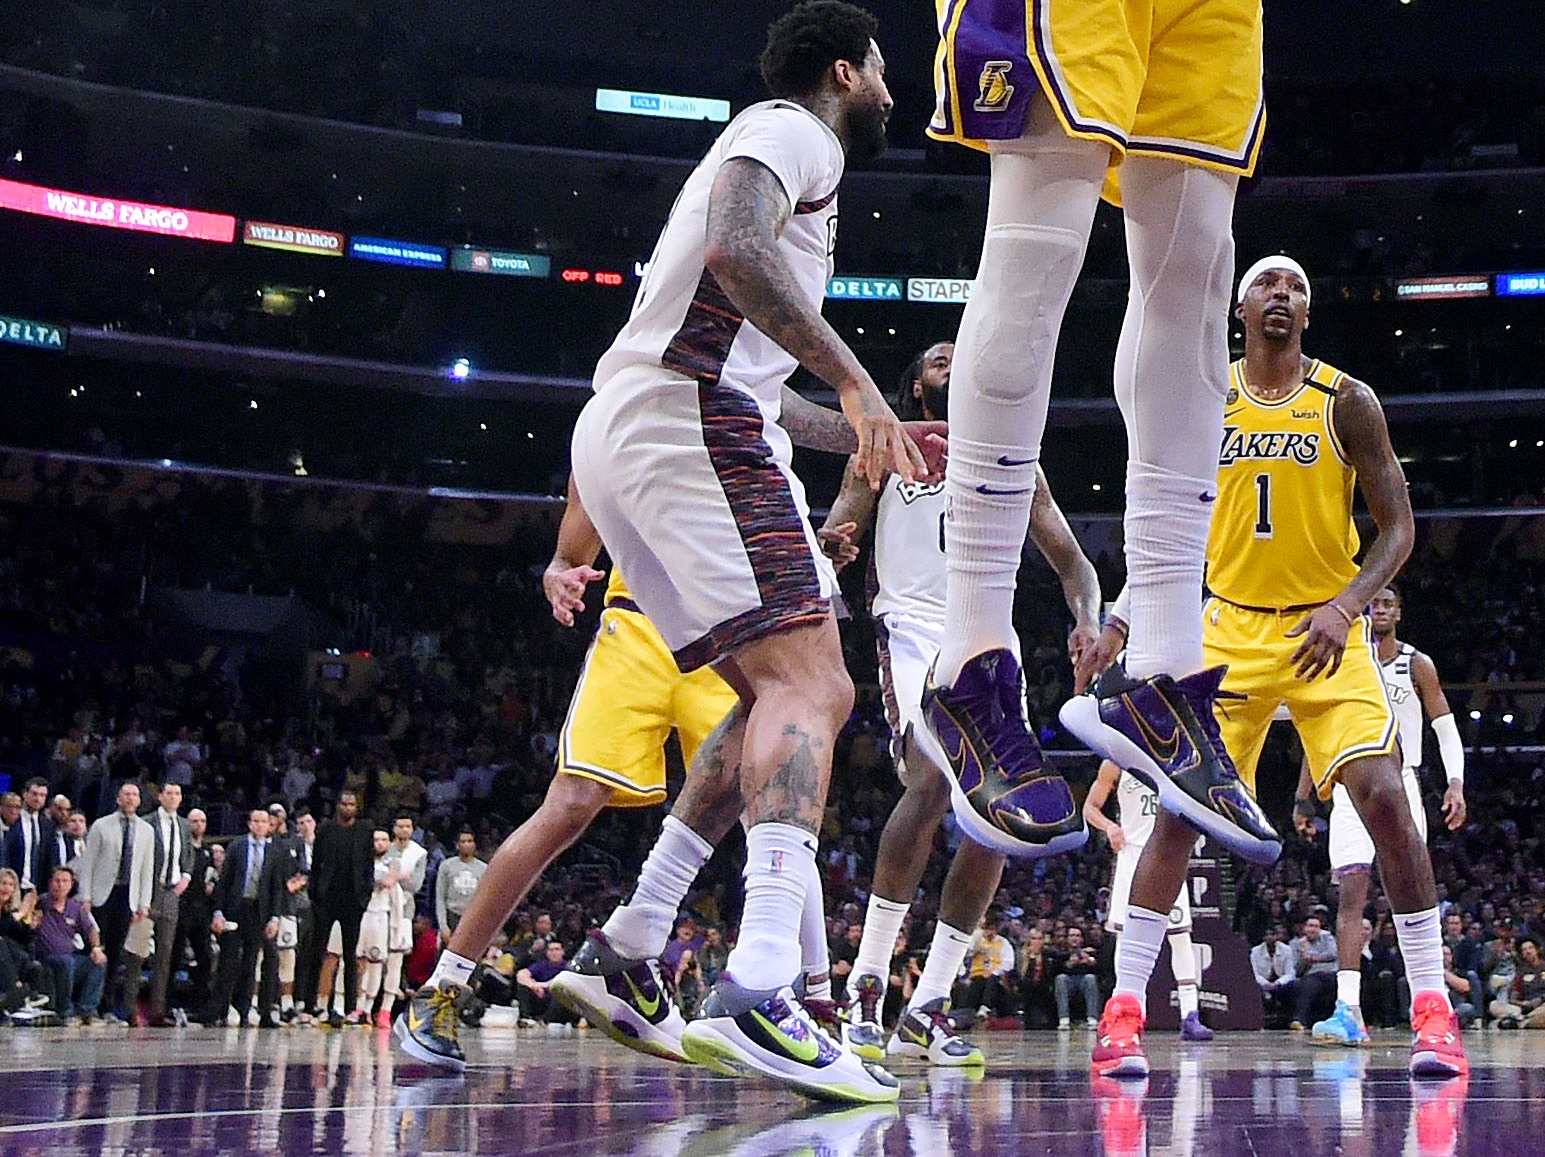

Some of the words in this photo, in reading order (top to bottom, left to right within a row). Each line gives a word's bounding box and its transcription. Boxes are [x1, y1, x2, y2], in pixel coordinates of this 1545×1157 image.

[47, 192, 115, 221] WELLS
[119, 204, 189, 231] FARGO
[250, 225, 294, 243] WELLS
[295, 231, 340, 249] FARGO
[491, 256, 531, 271] TOYOTA
[832, 281, 900, 297] DELTA
[1510, 278, 1537, 290] BUD
[0, 320, 62, 347] DELTA
[1292, 408, 1320, 420] wish
[1218, 425, 1320, 466] LAKERS
[1254, 471, 1274, 540] 1
[1140, 794, 1158, 817] 26
